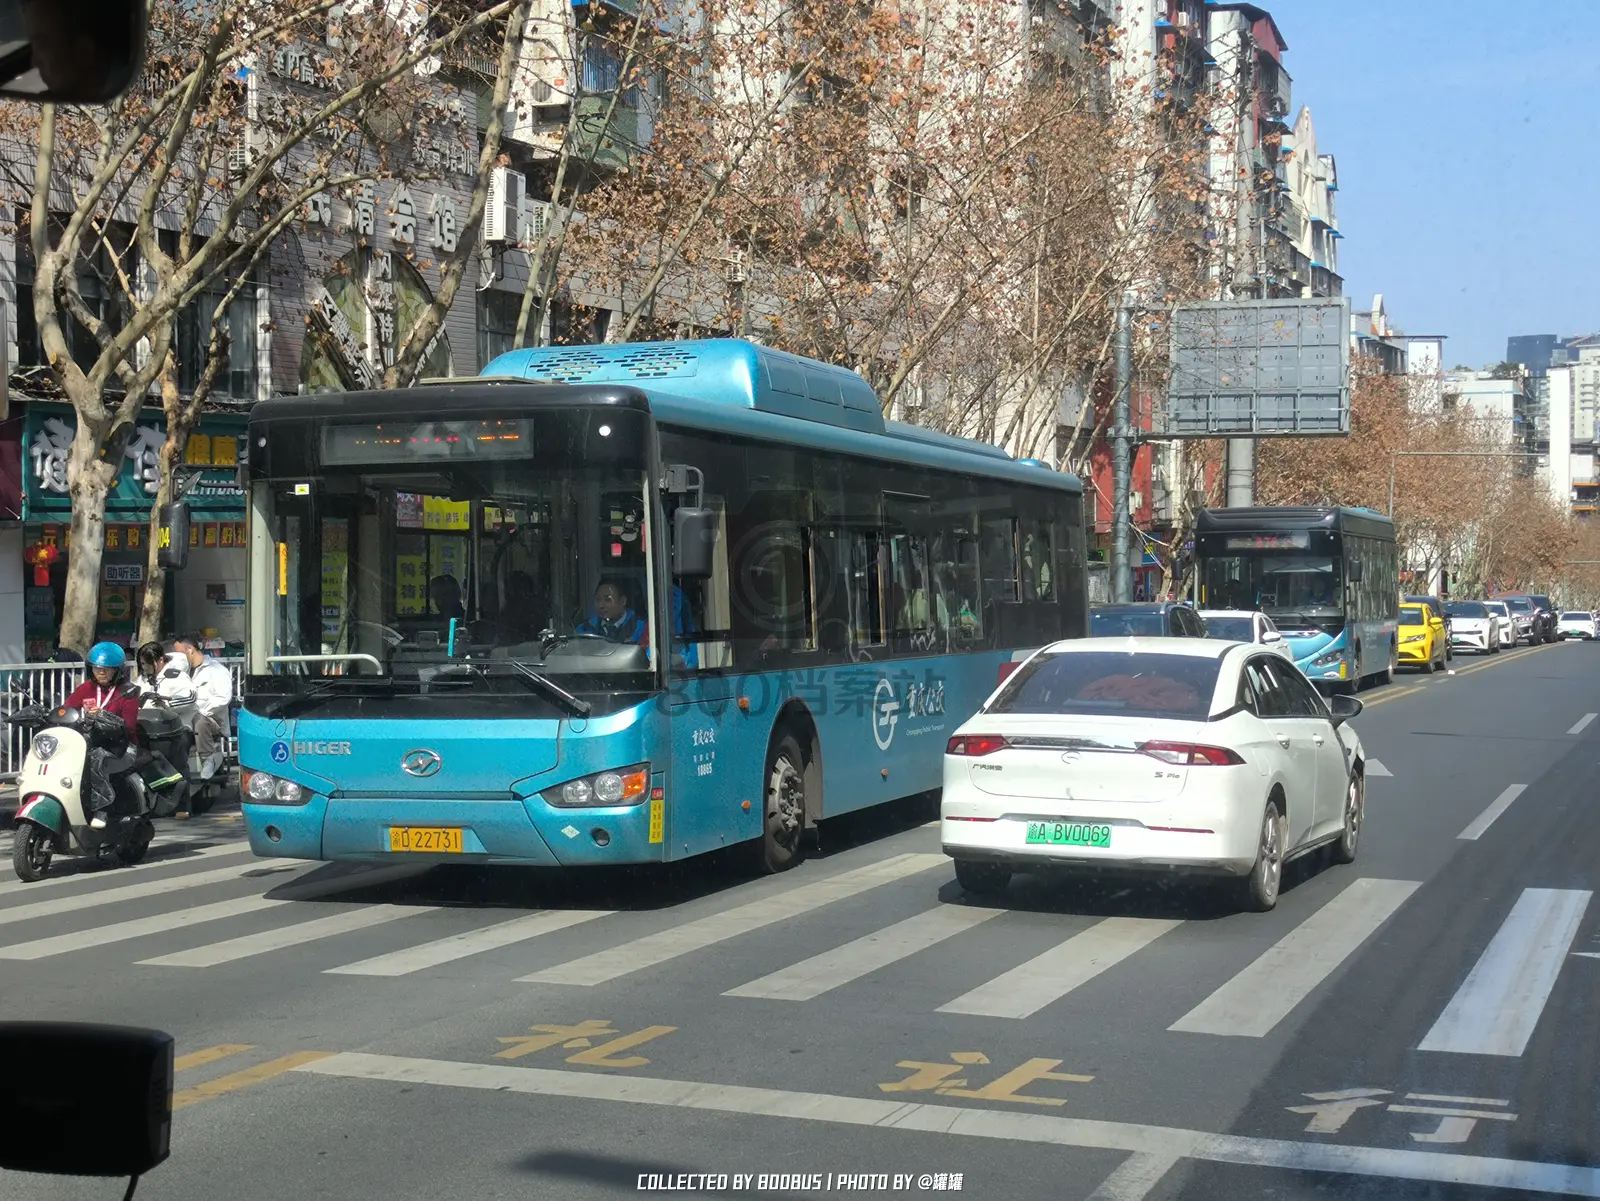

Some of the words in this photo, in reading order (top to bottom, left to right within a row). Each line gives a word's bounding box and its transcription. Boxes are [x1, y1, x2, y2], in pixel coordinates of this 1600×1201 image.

[107, 566, 141, 579] 助听器
[906, 680, 946, 719] 重庆公交
[692, 728, 715, 746] 重庆公交
[293, 740, 351, 756] HIGER
